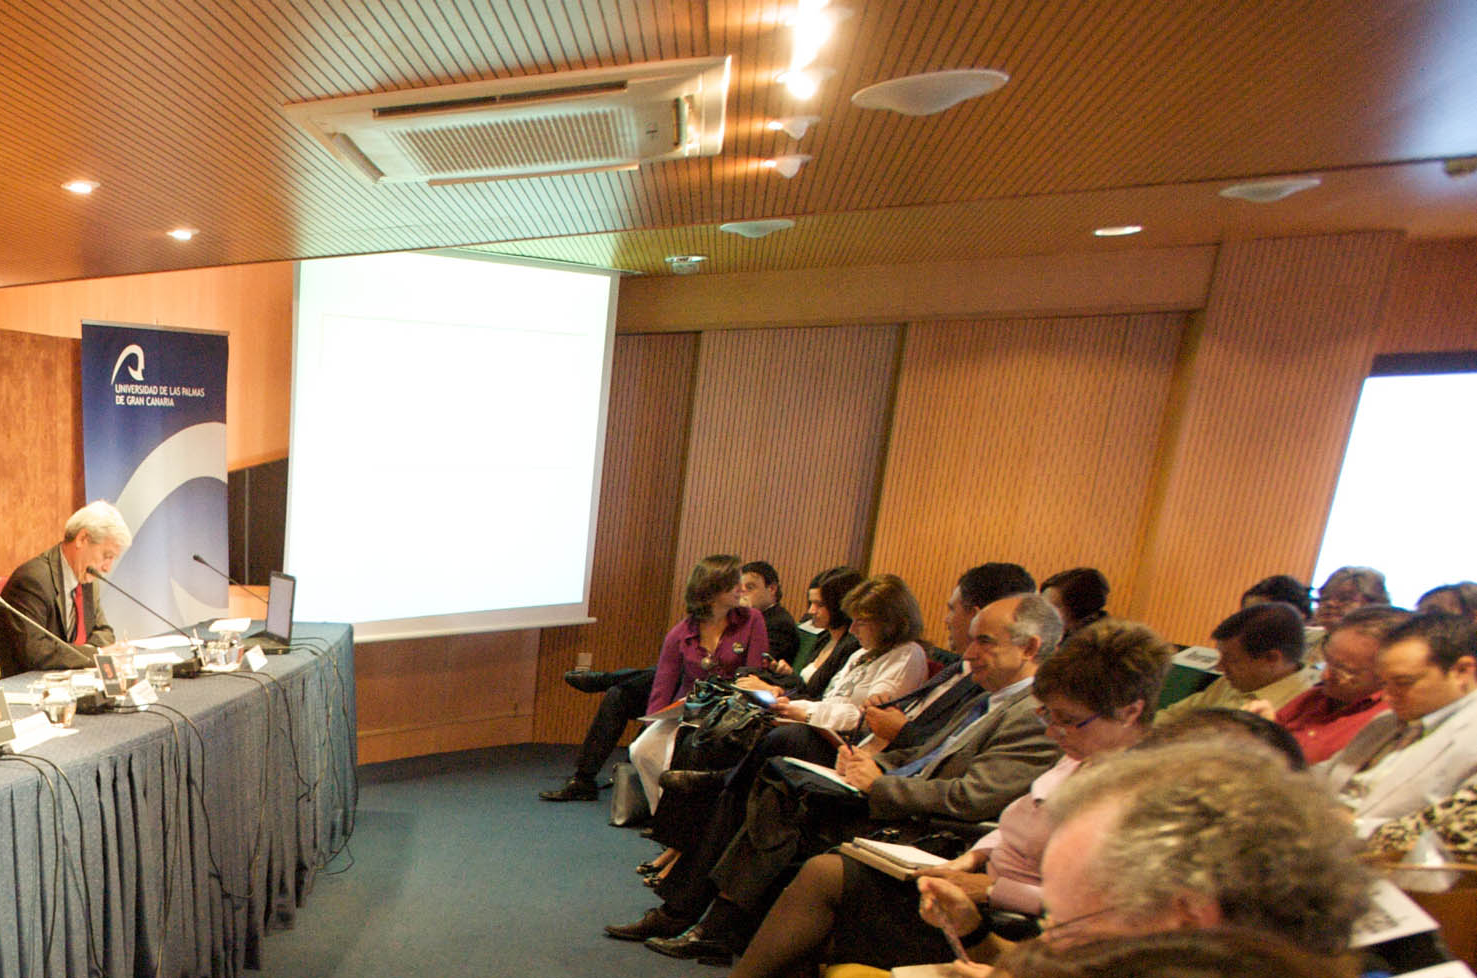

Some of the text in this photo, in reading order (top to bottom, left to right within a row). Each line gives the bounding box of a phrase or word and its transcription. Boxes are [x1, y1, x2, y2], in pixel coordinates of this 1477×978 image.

[115, 383, 205, 398] UNIVERSIDAD DE LAS PALMAS
[115, 394, 175, 407] DE GRAN CANARIA
